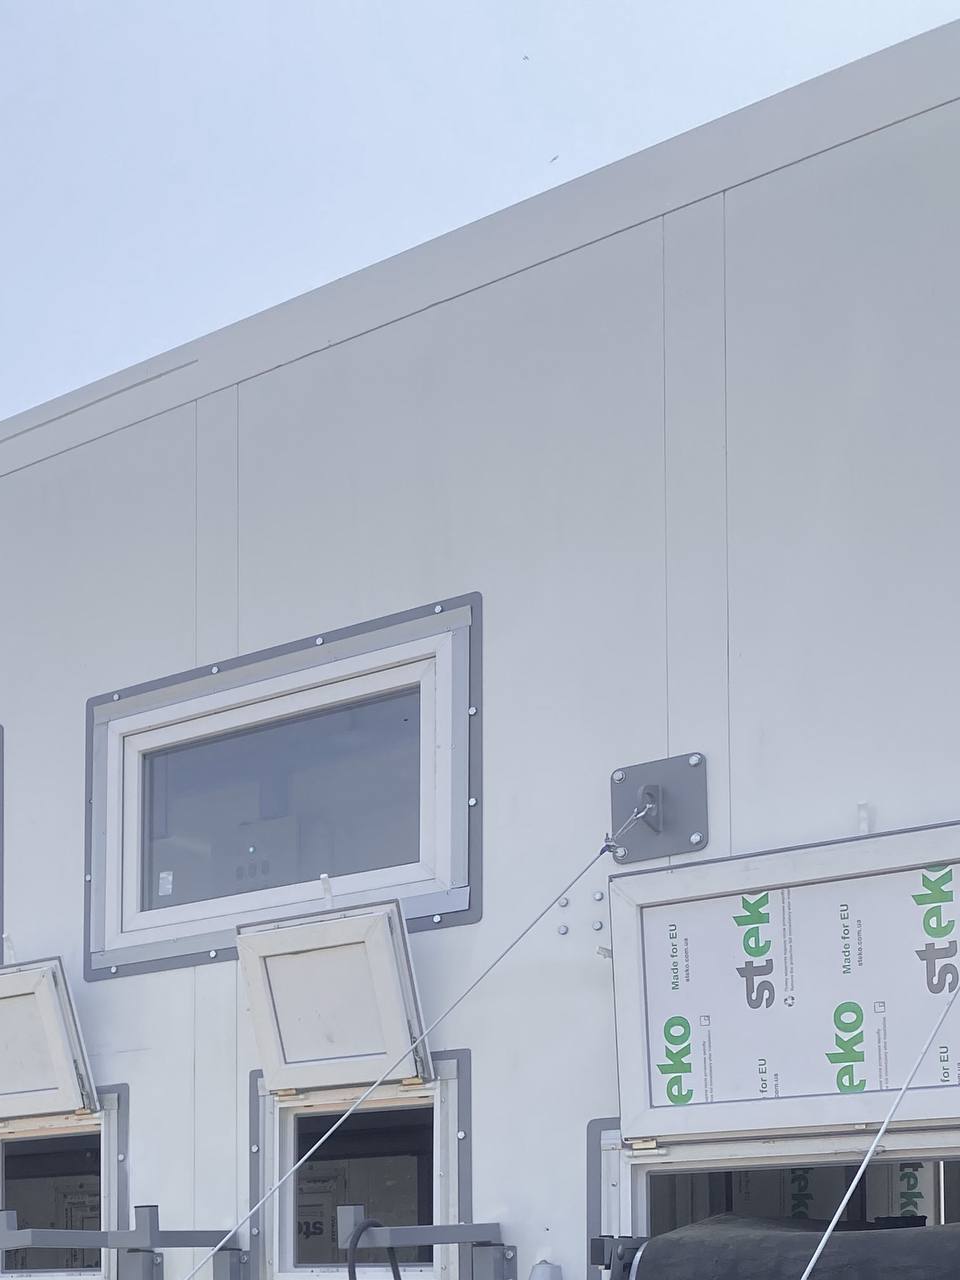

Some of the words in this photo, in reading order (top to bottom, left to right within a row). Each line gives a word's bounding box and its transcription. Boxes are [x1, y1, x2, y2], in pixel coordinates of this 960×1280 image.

[839, 903, 849, 920] EU
[669, 923, 678, 940] EU
[841, 923, 850, 940] for
[912, 864, 959, 995] stek
[670, 942, 679, 958] for
[732, 889, 775, 1009] stek
[841, 943, 852, 975] Made
[671, 960, 680, 991] Made
[656, 1015, 693, 1105] eko
[939, 1045, 949, 1062] EU
[758, 1058, 767, 1075] EU
[941, 1066, 950, 1083] for
[759, 1076, 768, 1093] for
